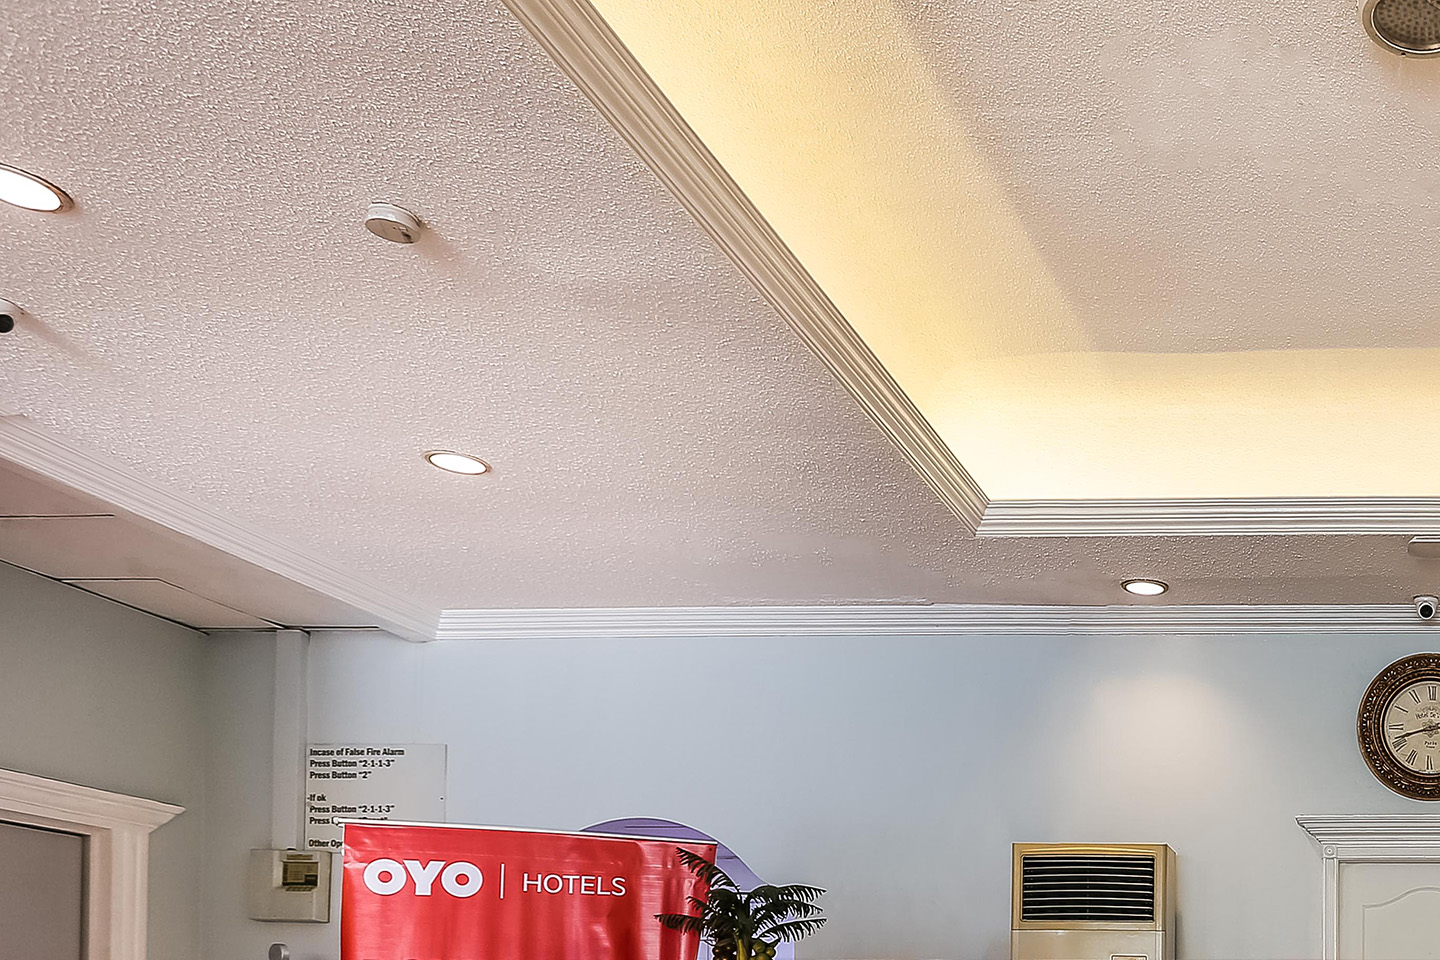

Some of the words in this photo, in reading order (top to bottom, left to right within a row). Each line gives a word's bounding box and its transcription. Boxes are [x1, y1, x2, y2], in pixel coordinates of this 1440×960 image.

[309, 748, 335, 756] Incase
[336, 748, 344, 756] of
[345, 748, 365, 756] False
[366, 748, 381, 756] Fire
[382, 748, 405, 756] Alarm
[309, 771, 331, 779] Press
[331, 771, 357, 779] Button
[309, 817, 331, 825] Press
[308, 840, 330, 848] Other
[363, 858, 483, 897] OYO
[522, 873, 627, 897] HOTELS
